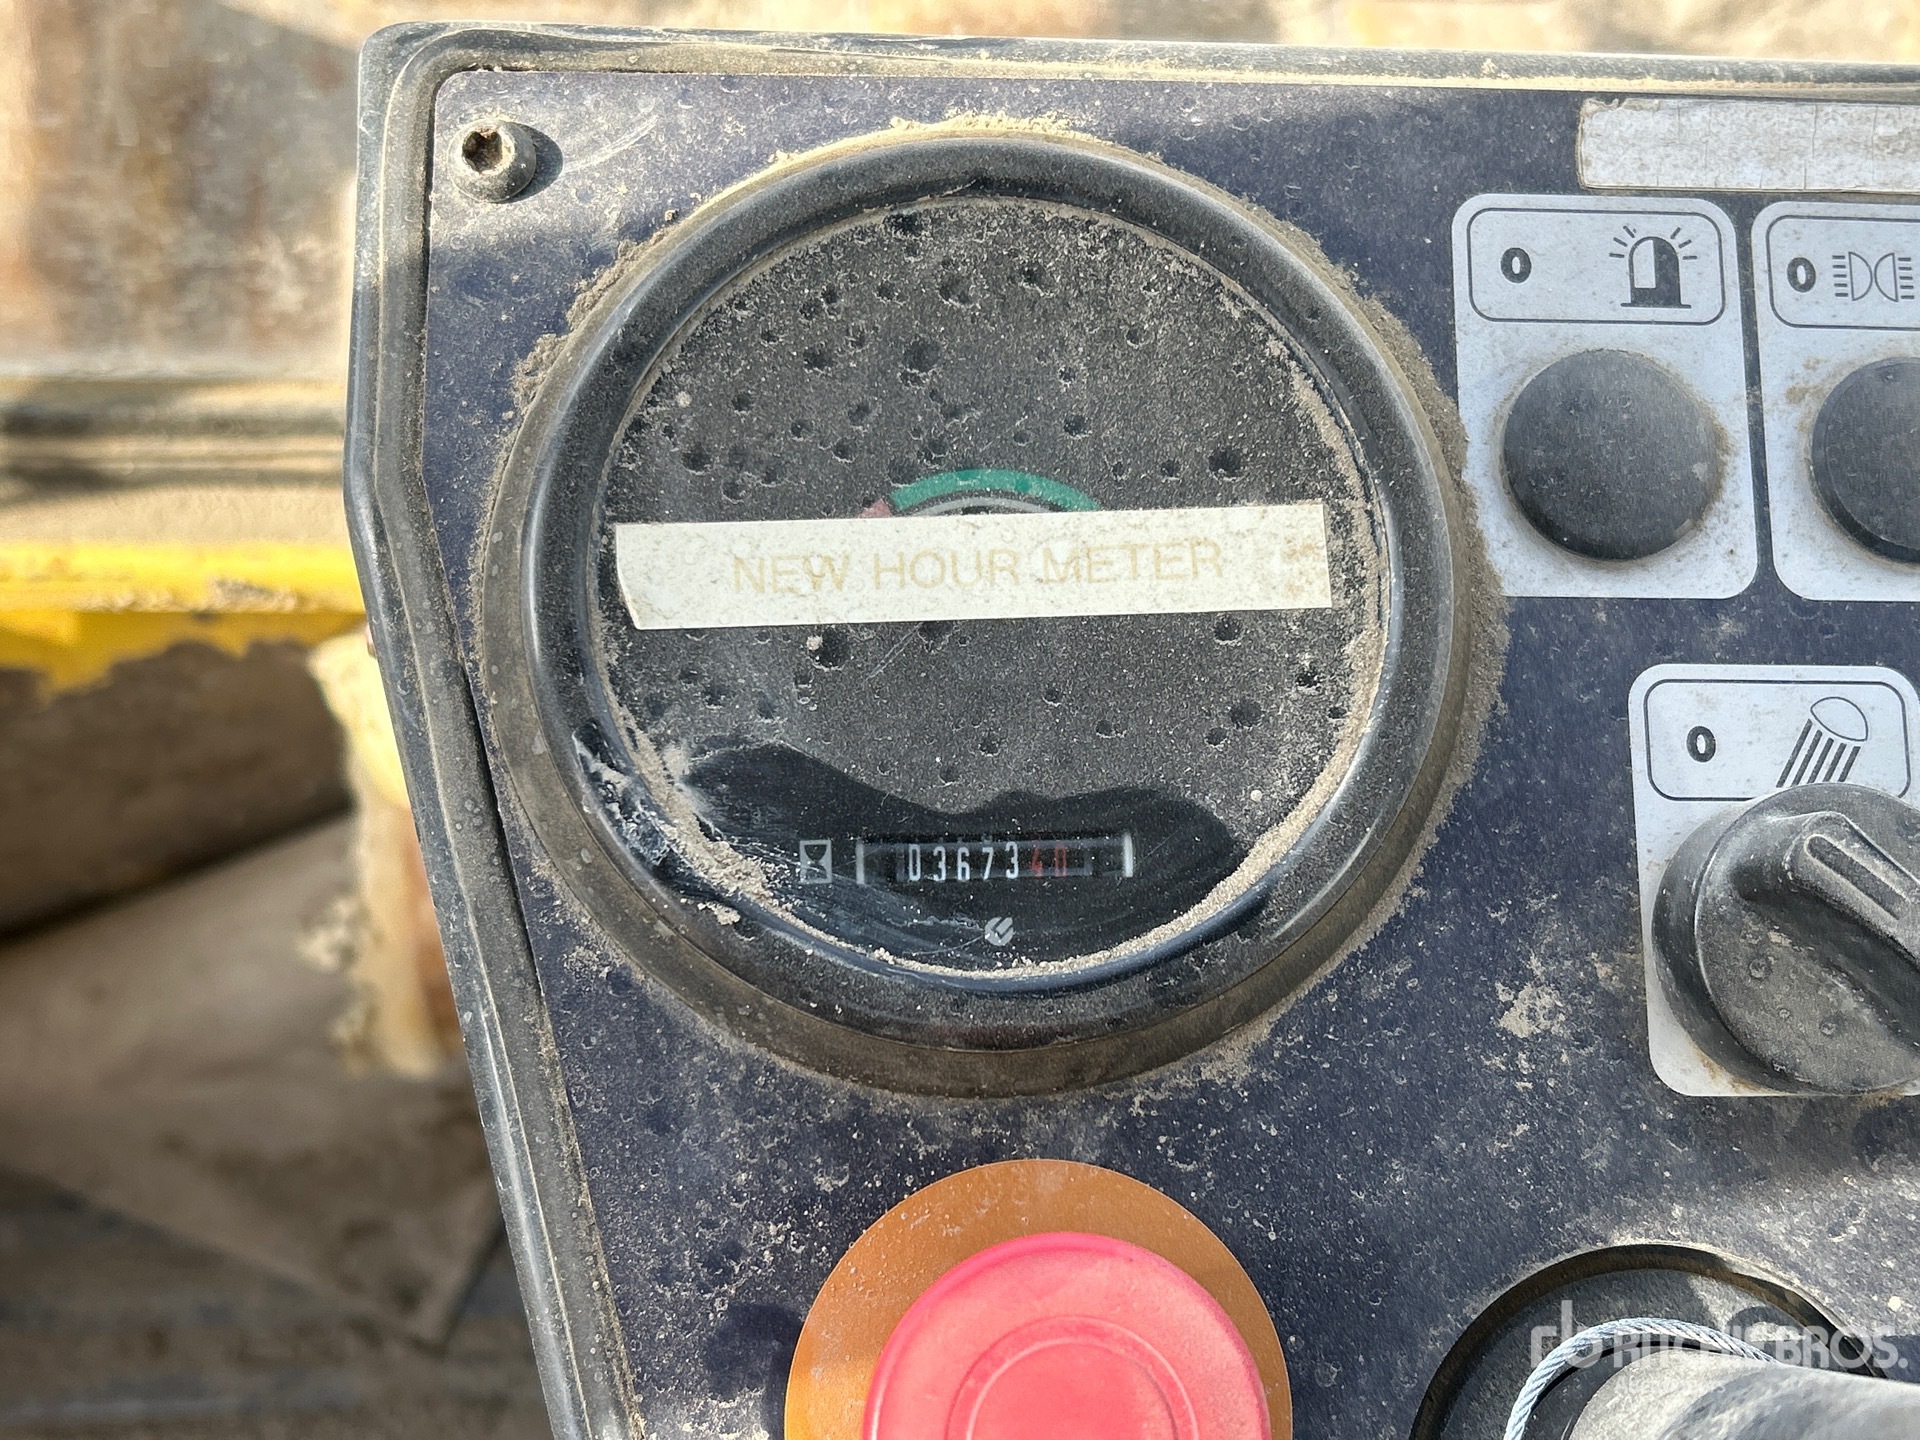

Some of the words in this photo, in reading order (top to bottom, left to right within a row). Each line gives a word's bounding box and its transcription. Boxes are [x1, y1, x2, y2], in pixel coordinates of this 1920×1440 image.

[1500, 247, 1532, 284] 0
[1786, 256, 1817, 293] 0
[732, 553, 849, 594] NEW
[872, 547, 1020, 590] HOUR
[1042, 537, 1223, 585] METER
[1686, 725, 1717, 763] 0
